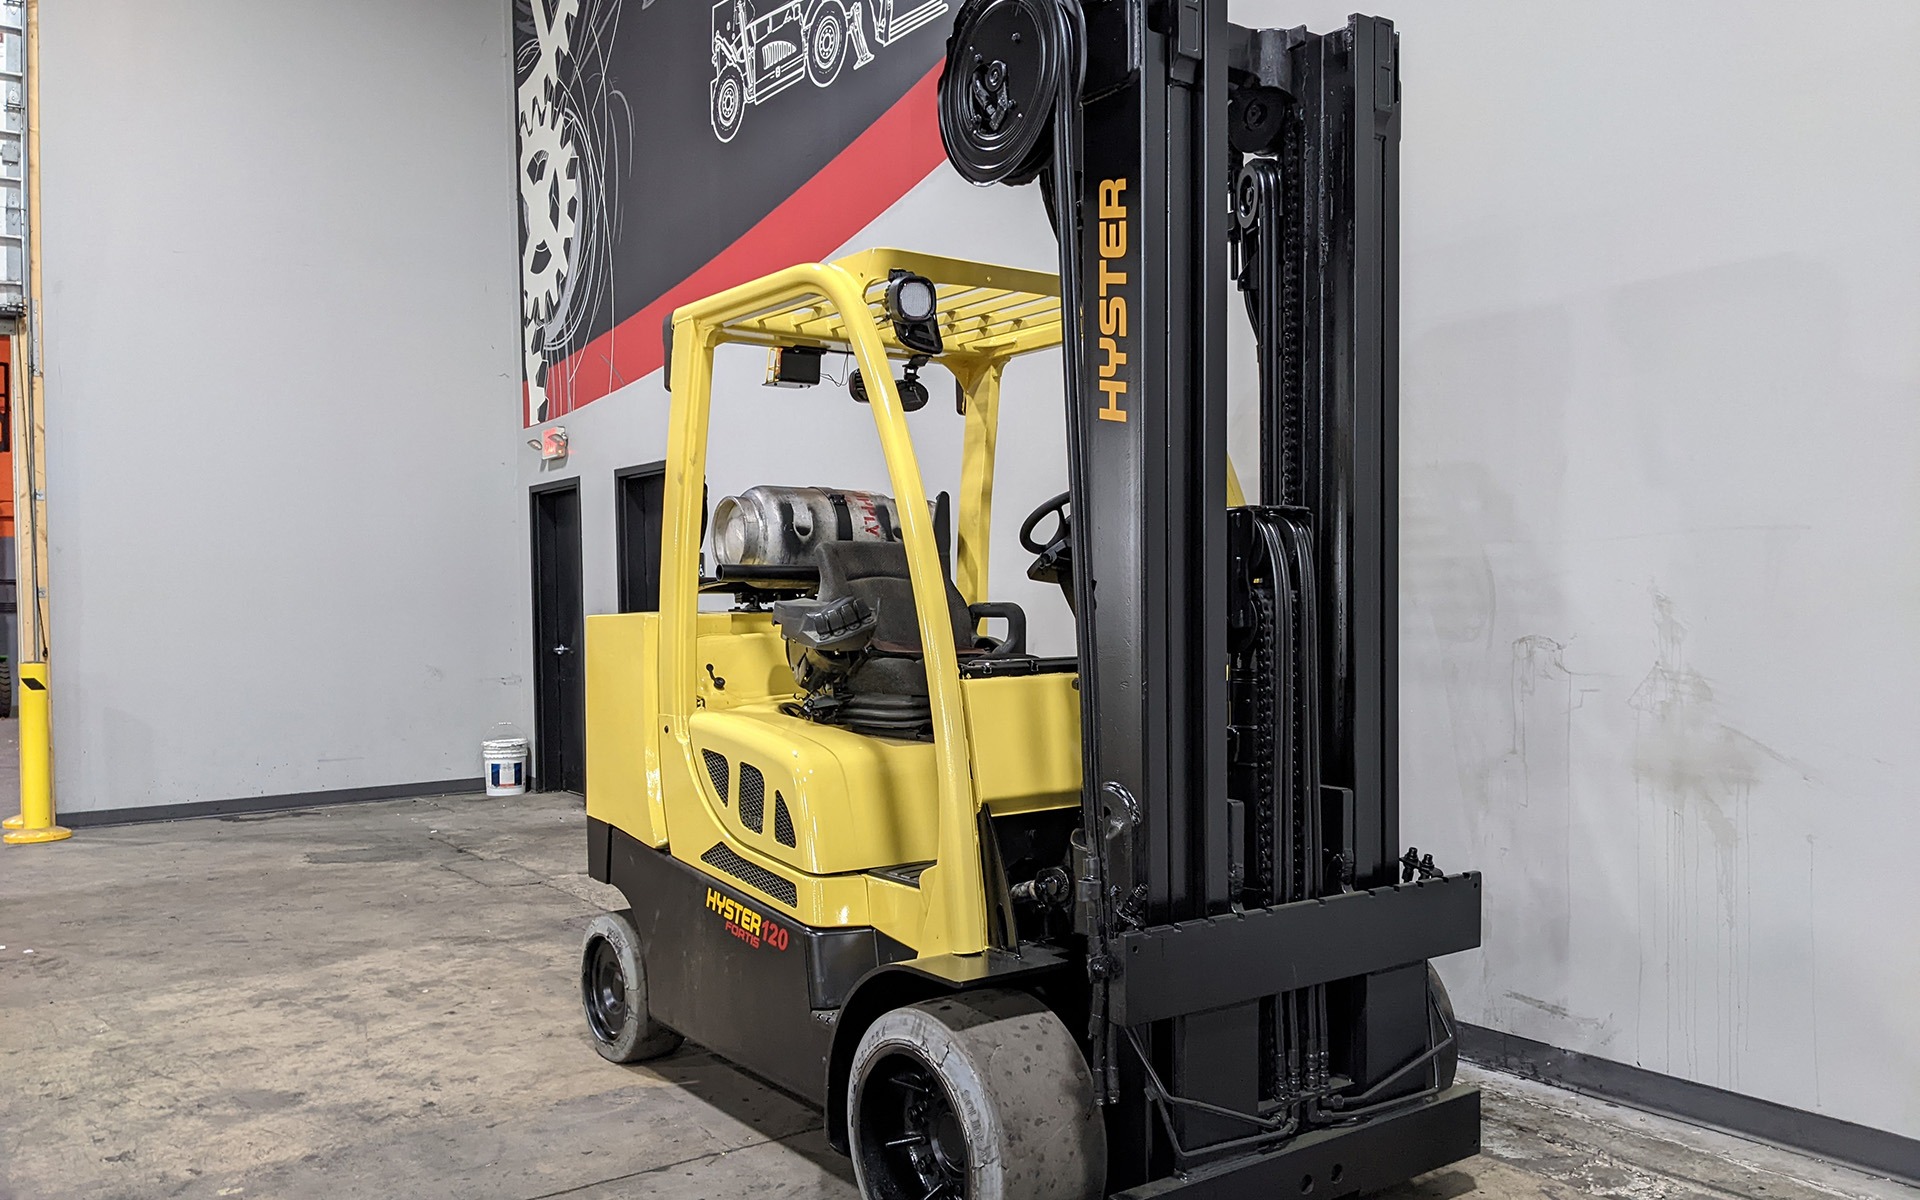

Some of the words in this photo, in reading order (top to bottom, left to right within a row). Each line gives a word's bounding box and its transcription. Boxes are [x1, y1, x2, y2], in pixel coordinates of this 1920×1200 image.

[1099, 178, 1127, 423] HYSTER
[706, 887, 762, 936] HYSTER
[761, 920, 789, 951] 120
[725, 921, 760, 949] FORTIS
